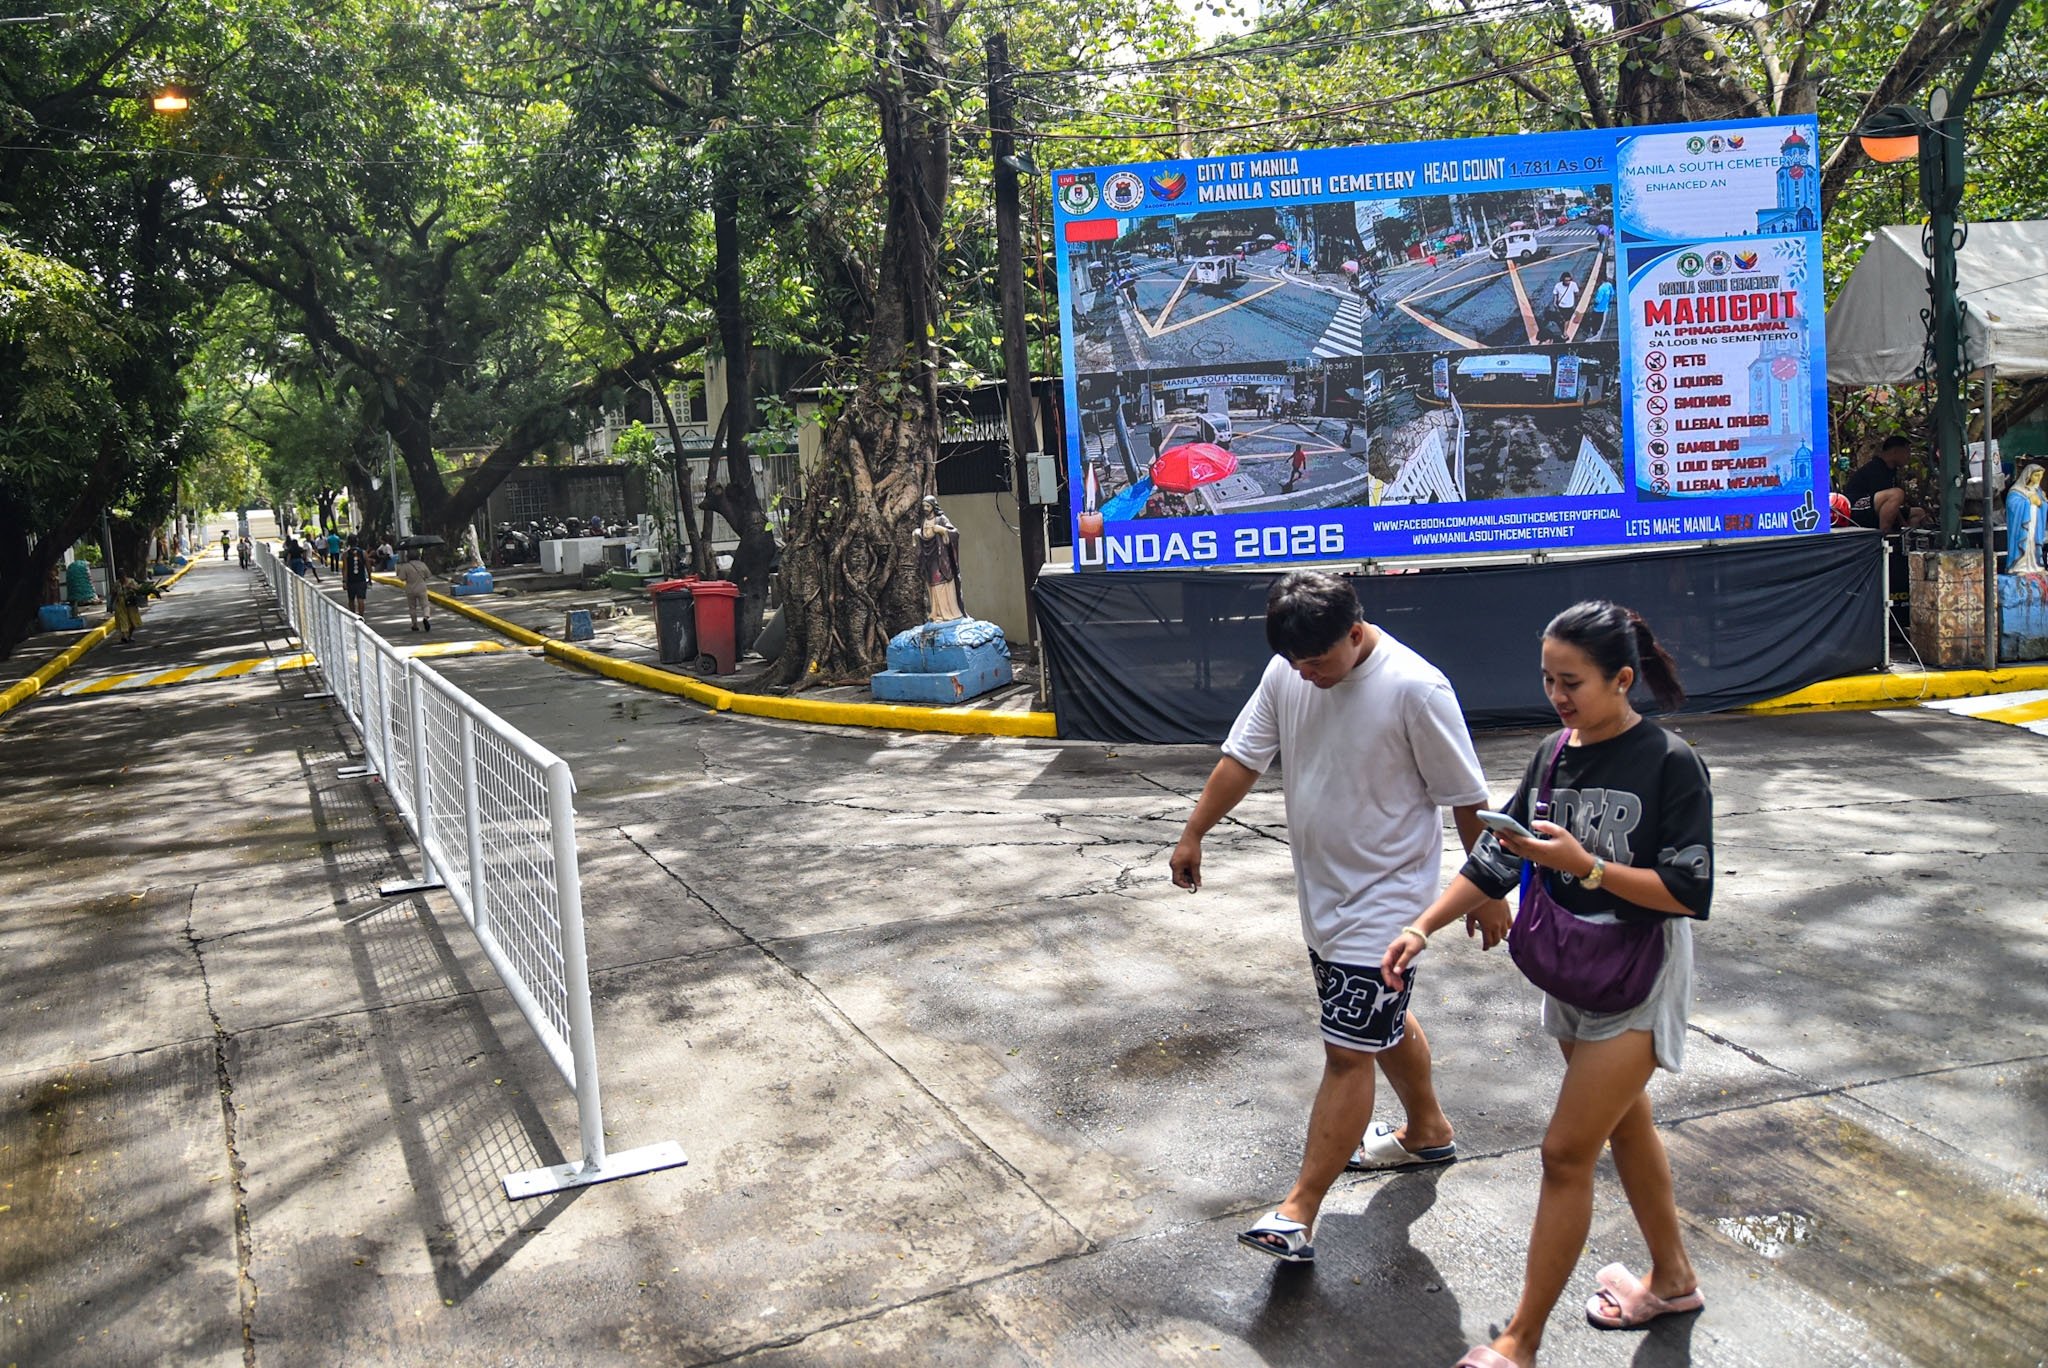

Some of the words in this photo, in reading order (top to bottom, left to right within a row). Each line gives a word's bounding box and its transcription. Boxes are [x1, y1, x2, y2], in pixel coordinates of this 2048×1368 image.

[1197, 163, 1225, 182] CITY
[1230, 161, 1245, 180] OF
[1250, 157, 1299, 178] MANILA
[1625, 165, 1674, 177] MANILA
[1680, 162, 1725, 172] SOUTH
[1198, 182, 1263, 203] MANILA
[1270, 177, 1322, 197] SOUTH
[1329, 170, 1416, 194] CEMETERY
[1423, 161, 1458, 184] HEAD
[1462, 157, 1505, 182] COUNT
[1510, 161, 1550, 177] 1,781
[1557, 159, 1578, 172] As
[1583, 156, 1604, 171] Of
[1646, 181, 1707, 192] ENHANCED
[1710, 179, 1727, 188] AN
[1658, 281, 1696, 296] MANILA
[1698, 279, 1728, 294] SOUTH
[1730, 276, 1780, 291] CEMETERY
[1644, 291, 1797, 327] MAHIGPIT
[1655, 330, 1671, 338] NA
[1674, 321, 1790, 337] IPINAGBABAWAL
[1649, 340, 1664, 348] SA
[1668, 338, 1698, 347] LOOB
[1702, 337, 1718, 345] NG
[1721, 332, 1798, 343] SEMENTERYO
[1673, 354, 1706, 368] PETS
[1163, 378, 1199, 387] MANILA
[1200, 375, 1234, 383] SOUTH
[1235, 374, 1283, 382] CEMETERY
[1674, 375, 1723, 389] LIQUORS
[1675, 395, 1731, 409] SMOKING
[1675, 417, 1723, 432] ILLEGAL
[1728, 415, 1769, 428] DRUGS
[1677, 439, 1739, 454] GAMBLING
[1677, 460, 1708, 473] LOUD
[1712, 456, 1767, 471] SPEAKER
[1677, 478, 1724, 492] ILLEGAL
[1728, 475, 1780, 490] WEAPON
[1625, 519, 1650, 537] LETS
[1652, 517, 1681, 535] MAKE
[1683, 515, 1721, 533] MANILA
[1758, 511, 1788, 530] AGAIN
[1078, 529, 1217, 566] UNDAS
[1234, 523, 1345, 558] 2026
[1412, 526, 1575, 546] WWW.MANILASOUTHCEMETERY.NET
[1317, 964, 1381, 1030] 23
